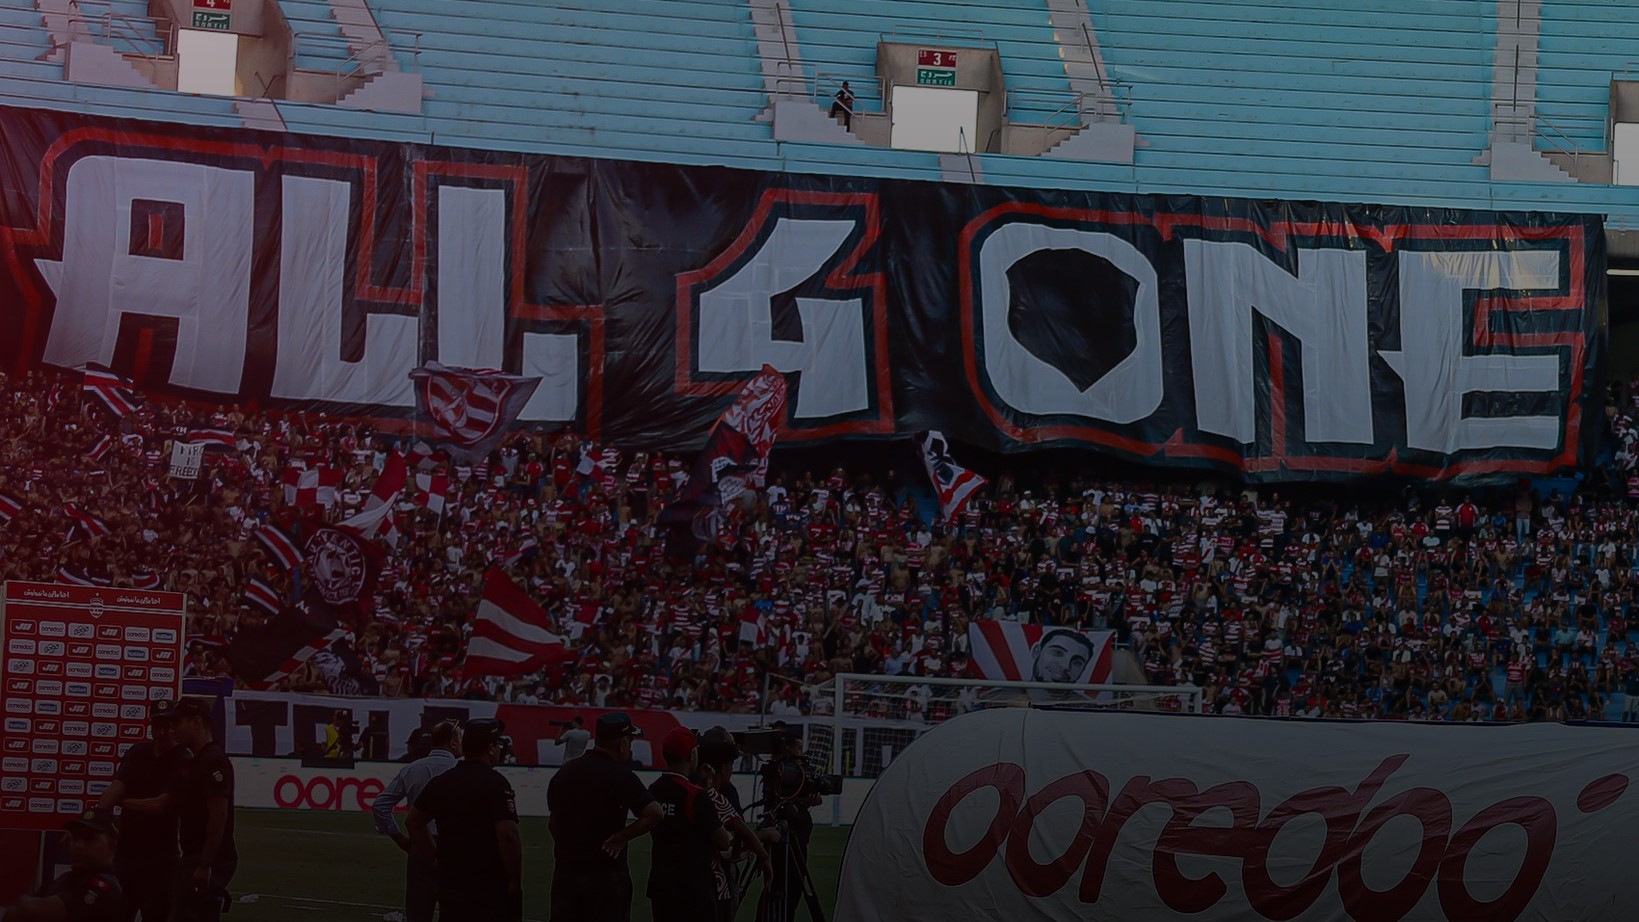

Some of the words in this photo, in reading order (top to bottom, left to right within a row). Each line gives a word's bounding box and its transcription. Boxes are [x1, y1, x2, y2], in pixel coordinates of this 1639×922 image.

[933, 52, 942, 66] 3
[920, 78, 953, 86] SORTIE
[34, 154, 579, 422] ALL
[696, 217, 871, 419] 4
[980, 221, 1562, 455] ONE
[274, 775, 407, 812] oore
[923, 753, 1557, 922] ooredoo
